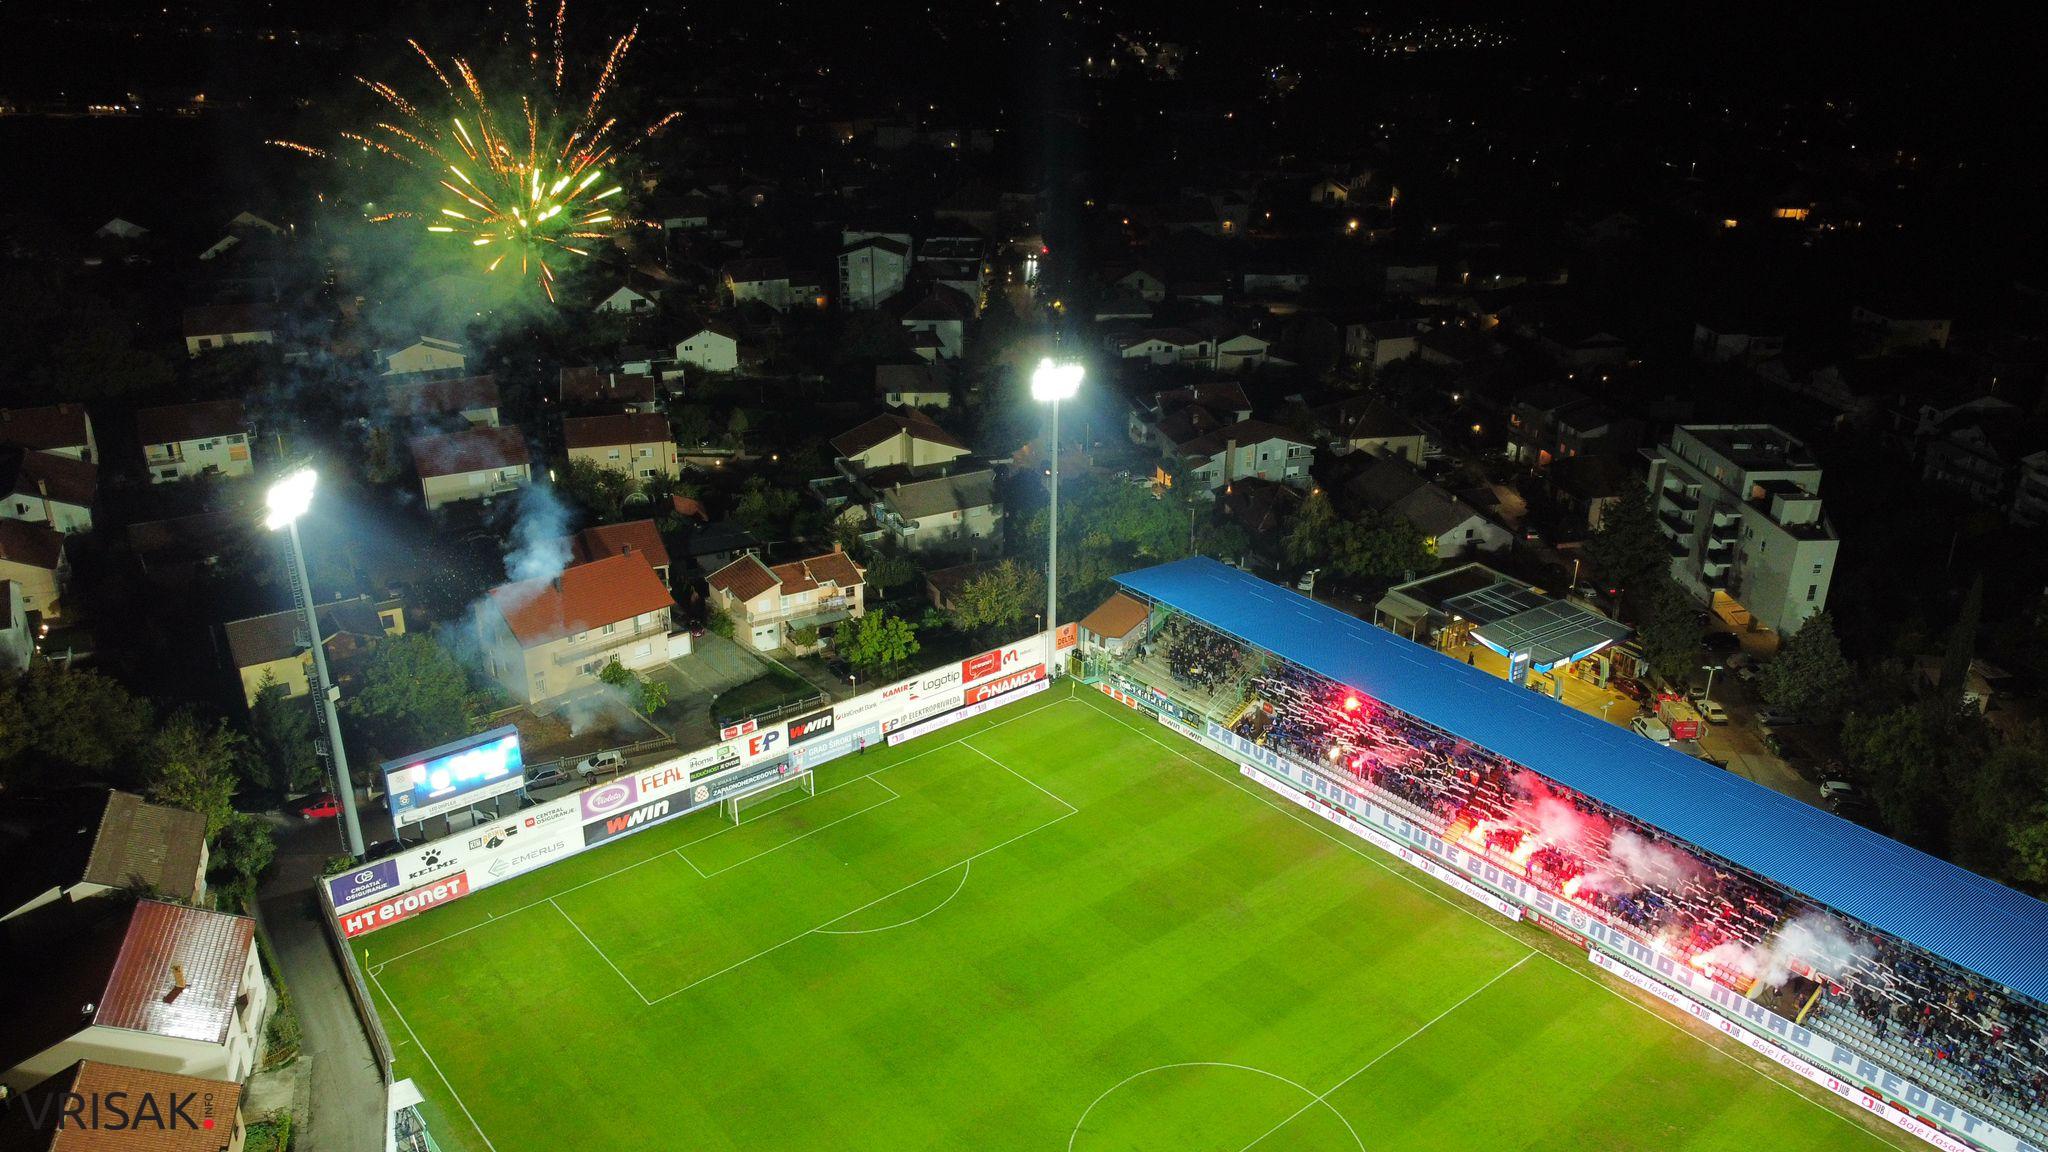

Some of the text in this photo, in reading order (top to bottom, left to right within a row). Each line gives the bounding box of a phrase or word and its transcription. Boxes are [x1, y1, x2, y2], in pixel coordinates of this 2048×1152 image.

[923, 671, 960, 690] Logotip
[749, 731, 779, 757] EP
[642, 767, 684, 793] FEAL
[535, 807, 564, 820] CENTRAL
[537, 808, 575, 825] OSIGURANJE
[512, 841, 565, 866] EMERUS
[409, 858, 457, 879] KELME
[346, 883, 388, 901] OSIGURANJE
[350, 879, 381, 894] CROATIA
[1209, 723, 1233, 745] ZA
[1301, 770, 1356, 810] GRAD
[1384, 813, 1459, 862] LJUDE
[1467, 856, 1527, 897] BORI
[1535, 892, 1570, 922] SE
[1711, 985, 1811, 1047] NIKAD
[346, 910, 376, 933] HT
[1623, 970, 1643, 985] Boje
[1648, 983, 1679, 1004] fasade
[1730, 1026, 1740, 1038] JUB
[1751, 1040, 1774, 1056] Boje
[1780, 1054, 1815, 1078] fasade
[1839, 1084, 1850, 1097] JUB
[1873, 1102, 1885, 1115] JUB
[1898, 1117, 1925, 1136] Boje
